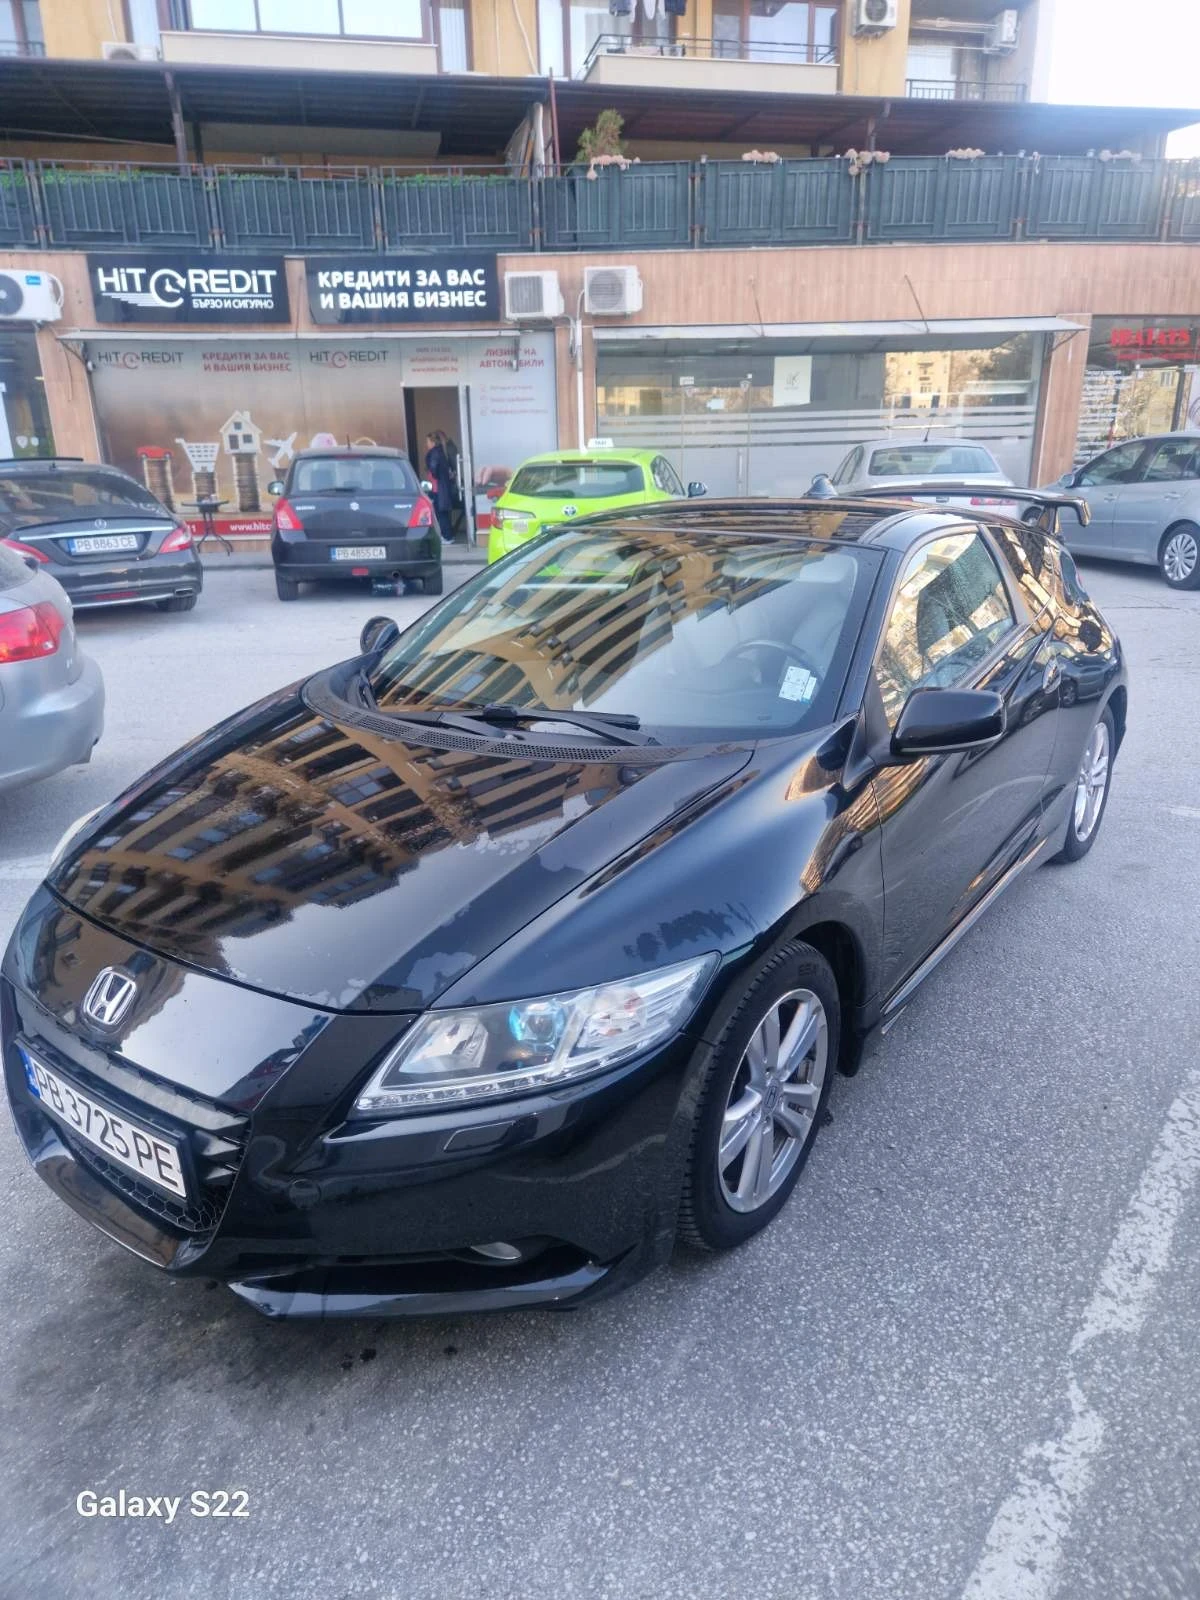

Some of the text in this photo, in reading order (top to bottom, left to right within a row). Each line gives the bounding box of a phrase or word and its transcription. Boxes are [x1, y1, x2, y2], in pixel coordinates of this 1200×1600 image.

[318, 269, 486, 291] КРЕДИТИ ЗА ВАС
[193, 298, 274, 309] БЪРЗО И СИГУРНО
[320, 290, 487, 309] И ВАШИЯ БИЗНЕС
[524, 347, 537, 356] НА
[202, 352, 290, 362] КРЕДИТИ ЗА ВАС
[204, 362, 292, 372] И ВАШИЯ БИЗНЕС
[479, 359, 545, 369] АВТОМБИЛИ
[33, 1062, 178, 1188] PB 3725 PE
